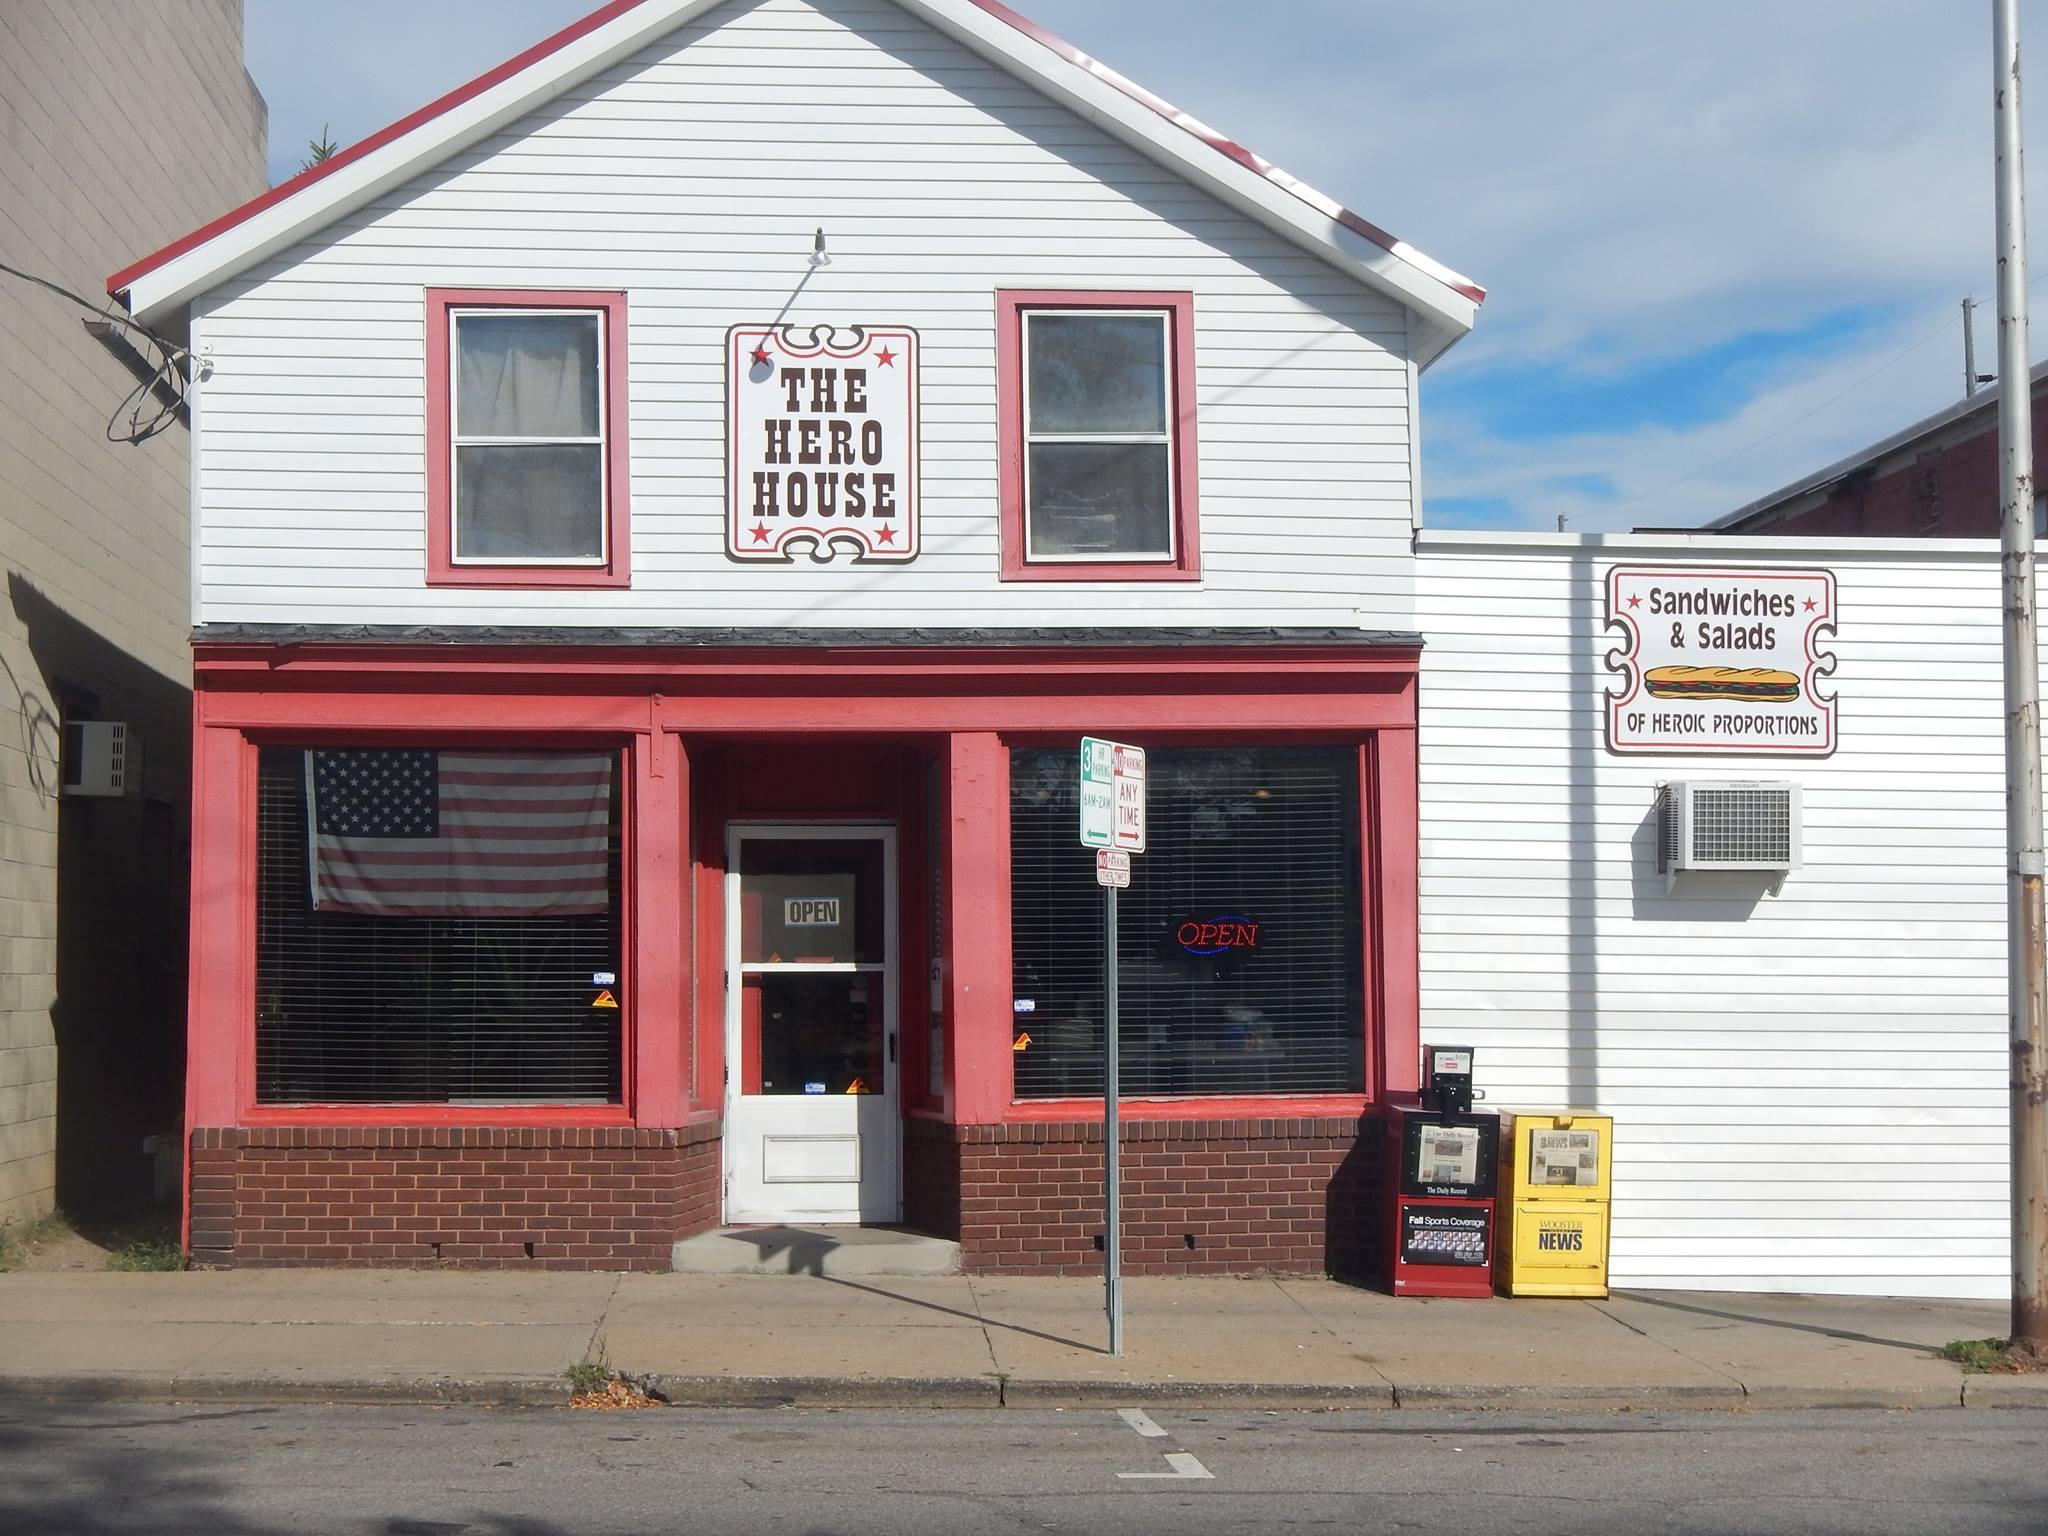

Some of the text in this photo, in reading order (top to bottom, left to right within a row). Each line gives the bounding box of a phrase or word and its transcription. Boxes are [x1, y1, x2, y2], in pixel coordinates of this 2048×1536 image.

[780, 367, 868, 413] THE
[764, 419, 883, 466] HERO
[752, 471, 896, 518] HOUSE
[1649, 587, 1796, 617] Sandwiches
[1670, 621, 1776, 650] & Salads
[1627, 712, 1818, 736] OF HEROIC PROPORTIONS
[1083, 746, 1091, 772] 3
[1114, 752, 1143, 771] NO PARKING
[1092, 762, 1111, 778] PARKING
[1120, 783, 1137, 802] ANY
[1119, 805, 1138, 826] TIME
[1099, 854, 1107, 868] NO
[1114, 871, 1127, 883] TIMES
[789, 901, 837, 923] OPEN
[1178, 922, 1258, 946] OPEN
[1427, 1186, 1467, 1195] The Daily Record
[1409, 1216, 1424, 1225] Fall
[1425, 1217, 1450, 1226] Sports
[1450, 1217, 1485, 1228] Coverage
[1539, 1220, 1583, 1229] WOOSTER
[1539, 1233, 1582, 1250] NEWS
